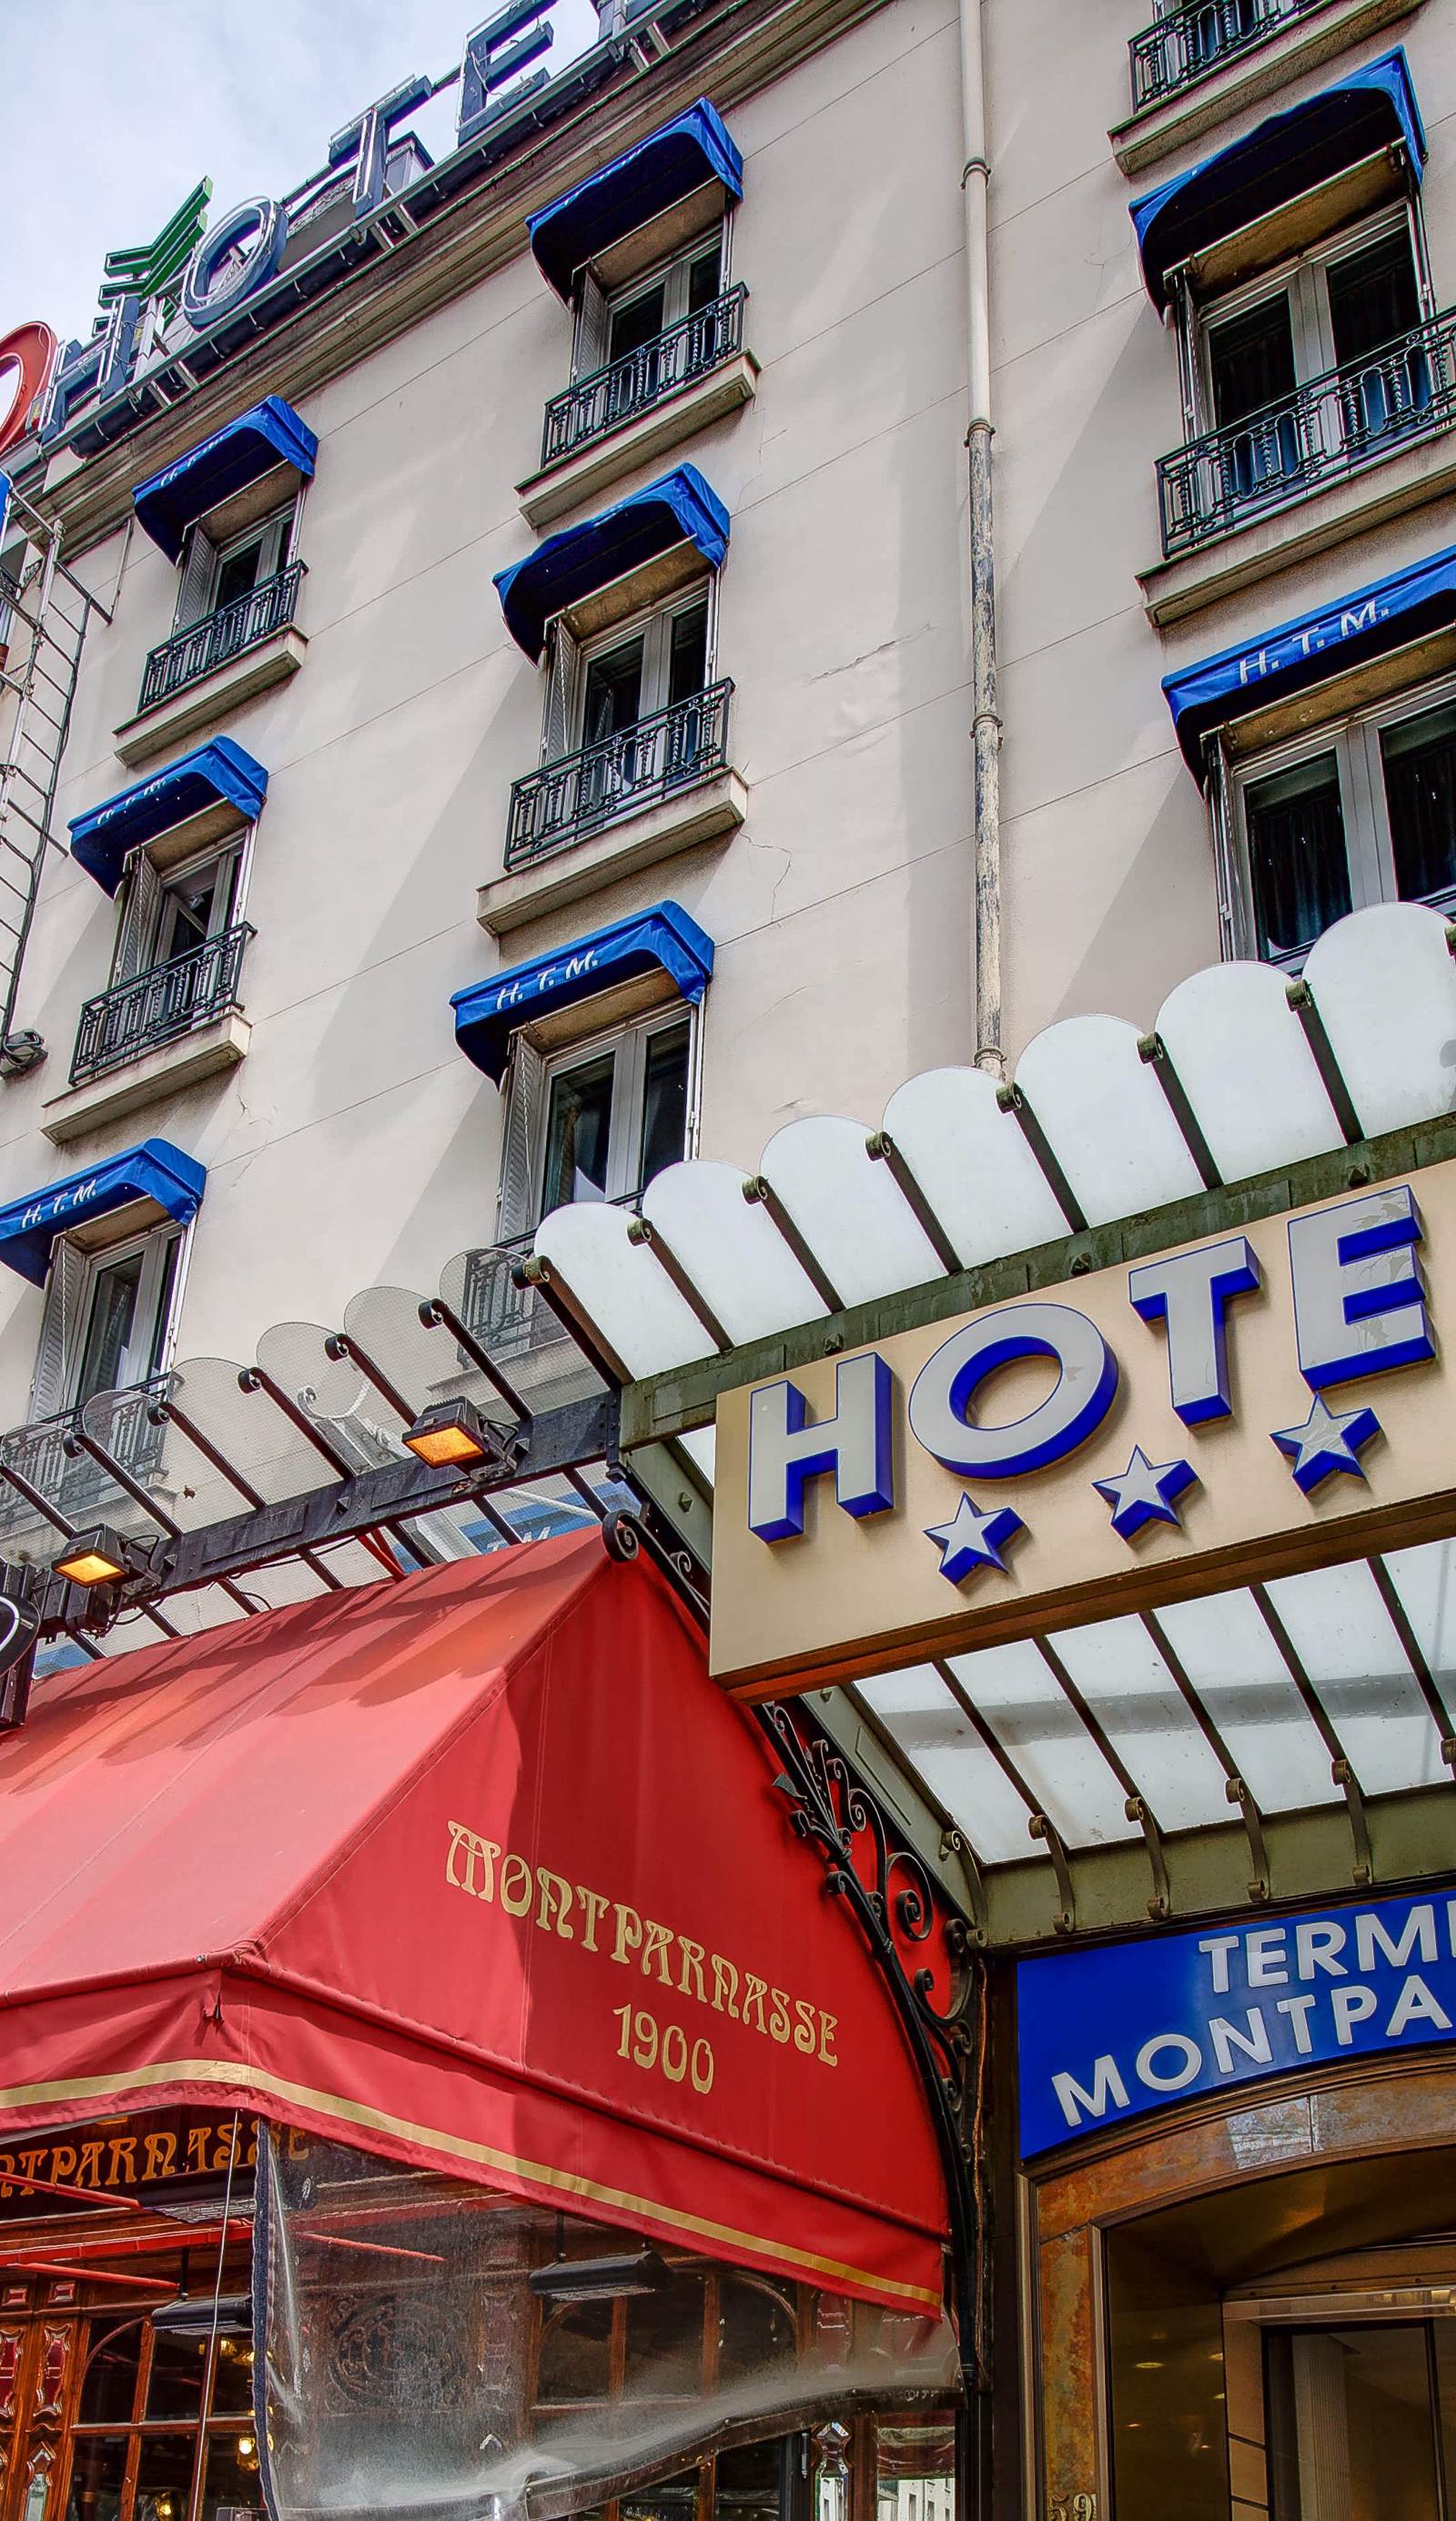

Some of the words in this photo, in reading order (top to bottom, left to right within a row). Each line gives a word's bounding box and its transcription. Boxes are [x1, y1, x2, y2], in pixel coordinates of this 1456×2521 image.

[1239, 651, 1279, 684] H.
[1291, 626, 1325, 655] T.
[1340, 598, 1390, 637] M.
[496, 982, 523, 1010] H.
[537, 967, 556, 991] T.
[565, 949, 599, 980] M.
[21, 1204, 42, 1229] H.
[53, 1191, 68, 1214] T.
[73, 1179, 96, 1206] M.
[747, 1184, 1437, 1545] HOTE
[445, 1819, 839, 2068] MONTPARNASSE
[612, 2003, 715, 2095] 1900
[1050, 1973, 1453, 2128] MONTPA
